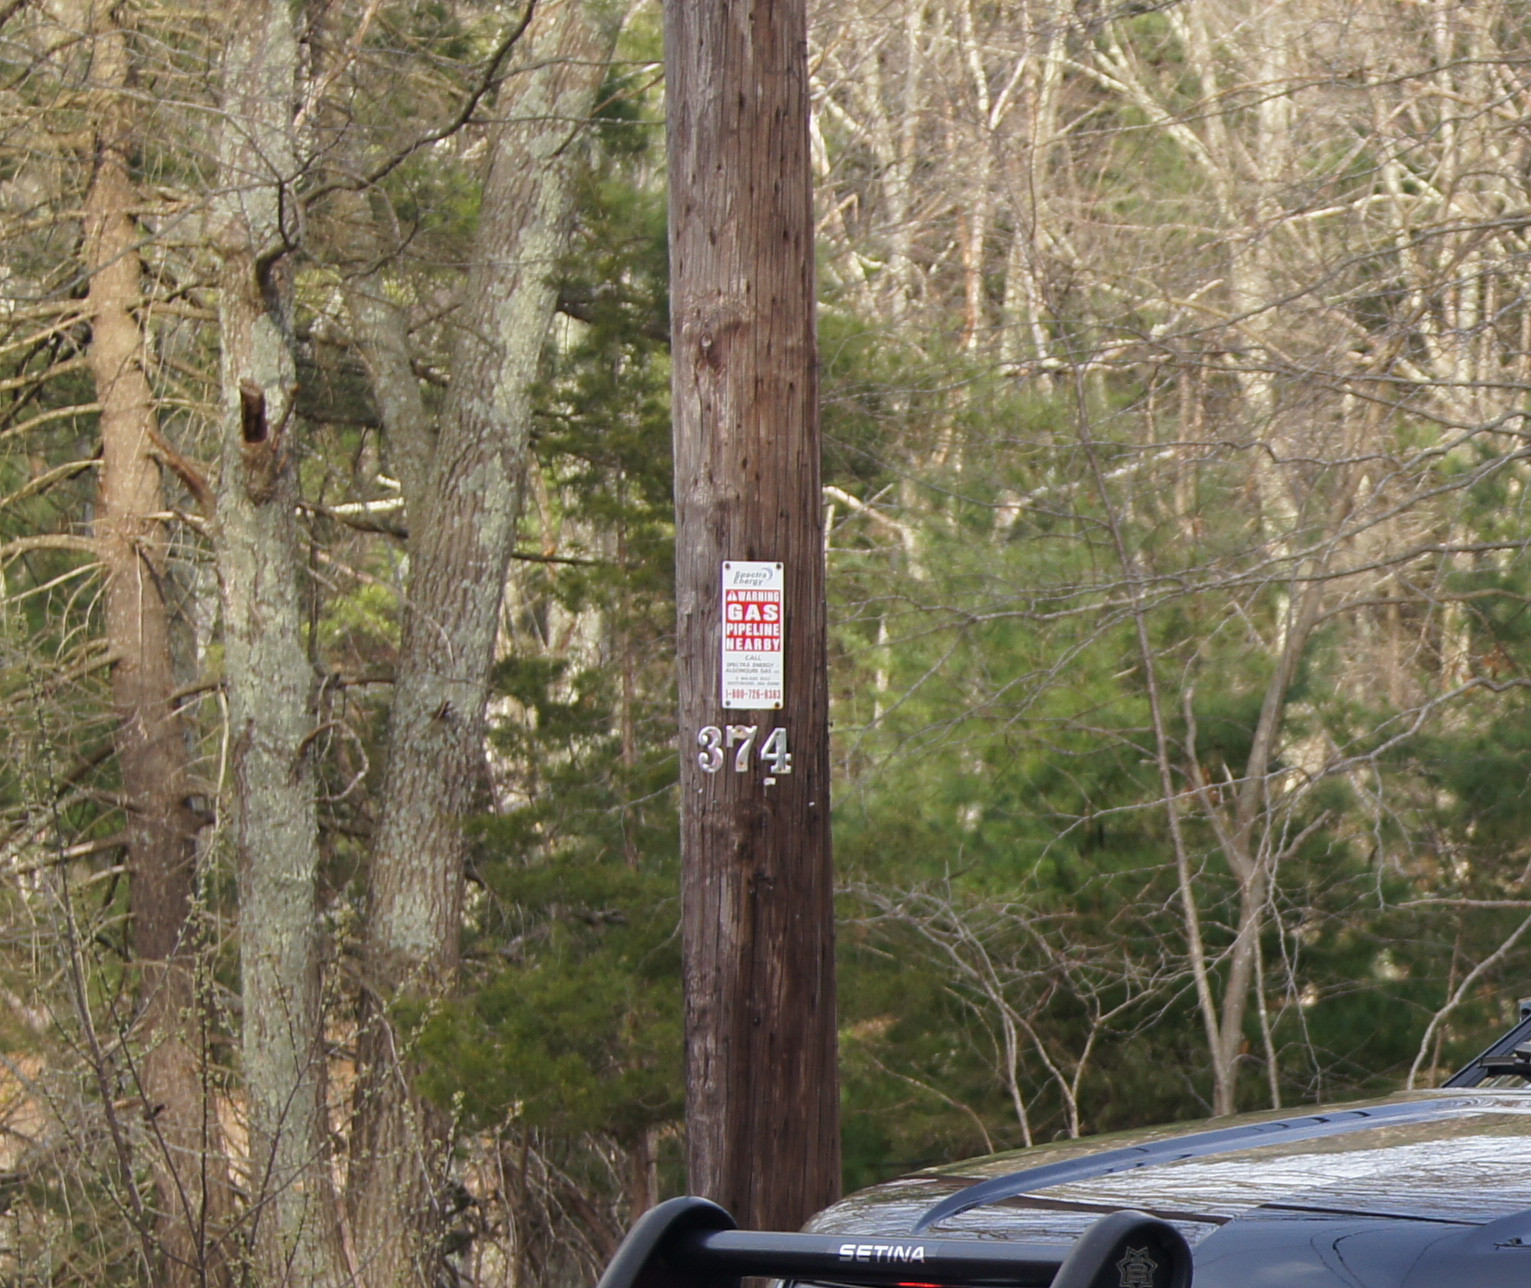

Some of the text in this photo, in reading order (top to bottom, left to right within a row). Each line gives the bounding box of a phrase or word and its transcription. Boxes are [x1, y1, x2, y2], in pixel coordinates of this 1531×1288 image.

[735, 570, 767, 580] Spectra
[738, 591, 780, 602] WARNING
[727, 604, 779, 621] GAS
[726, 623, 780, 636] PIPELINE
[726, 638, 781, 650] NEARBY
[698, 725, 791, 774] 374
[839, 1244, 925, 1263] SETINA
